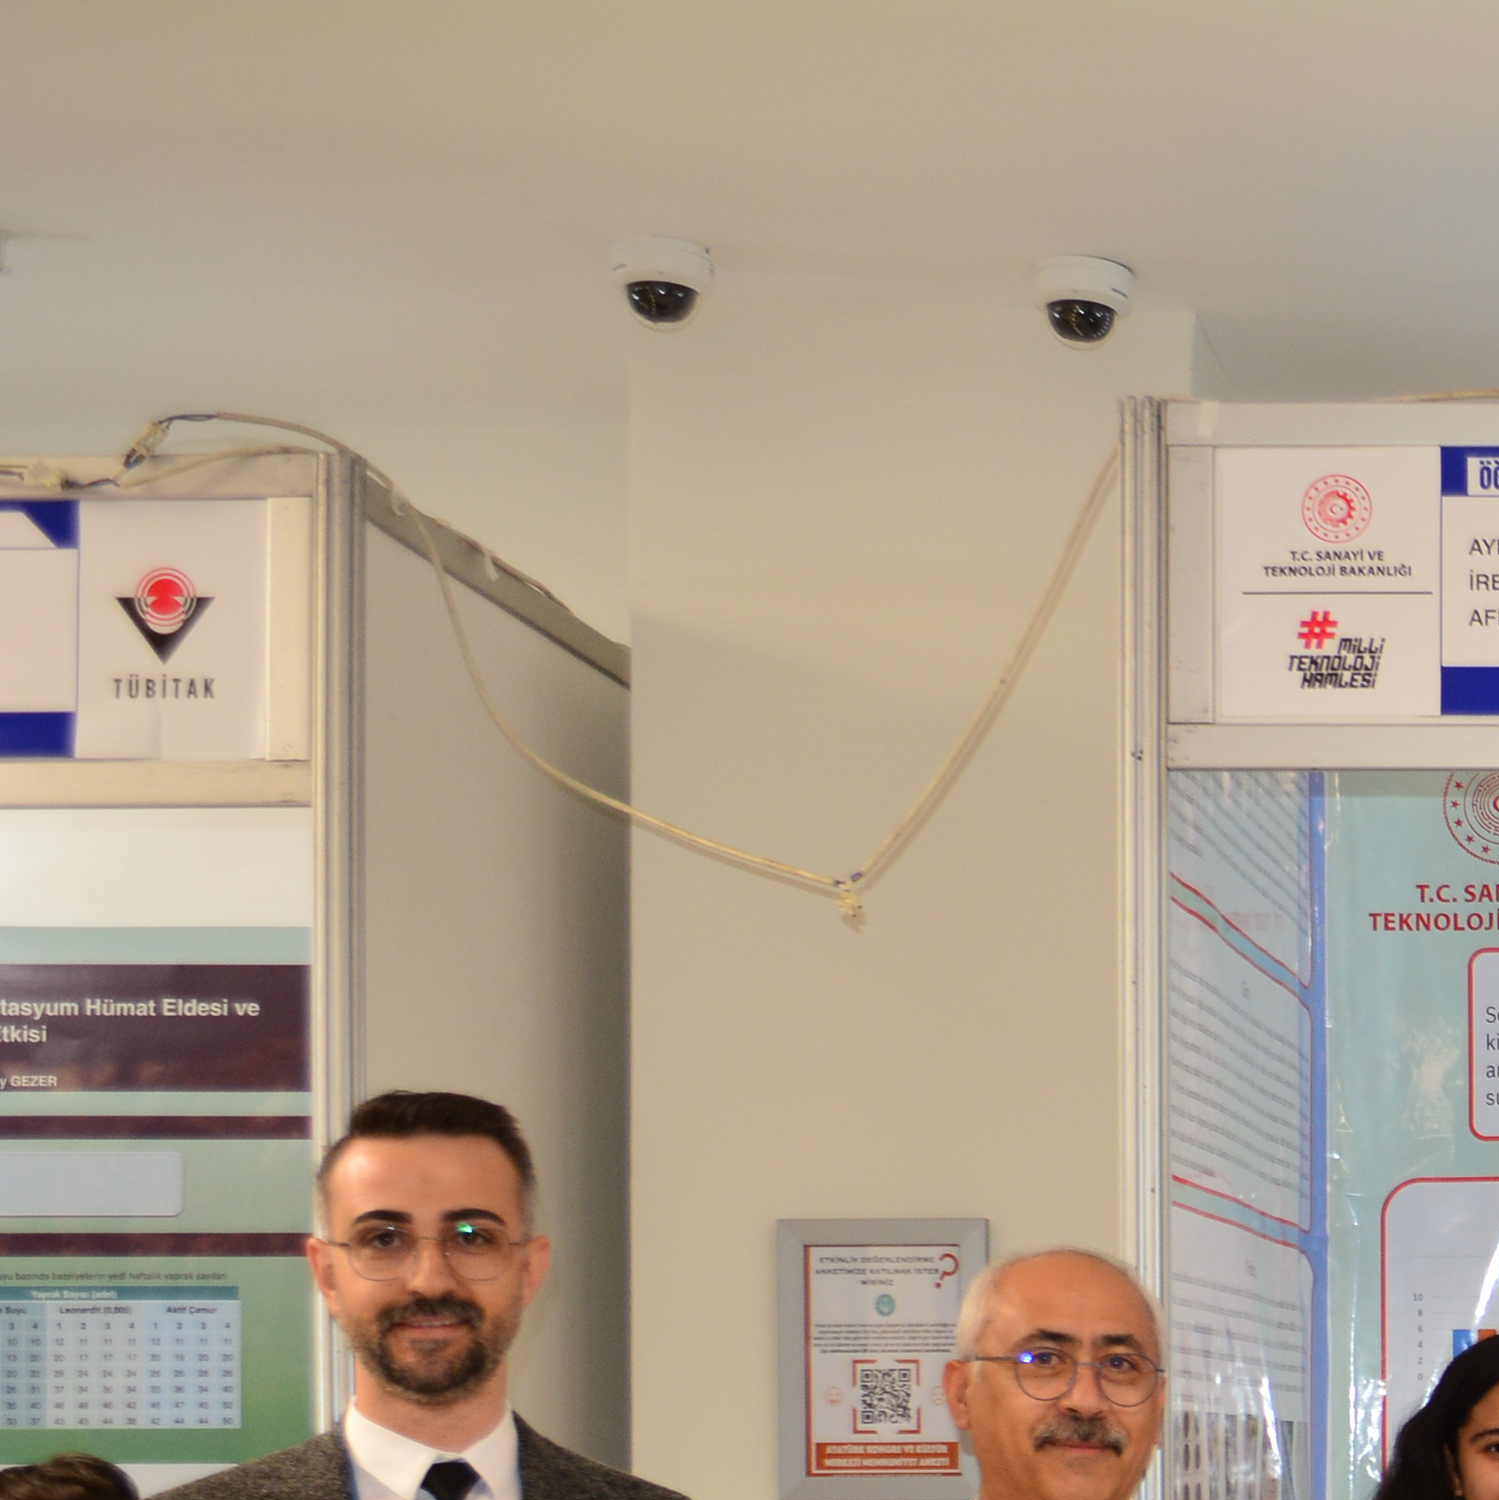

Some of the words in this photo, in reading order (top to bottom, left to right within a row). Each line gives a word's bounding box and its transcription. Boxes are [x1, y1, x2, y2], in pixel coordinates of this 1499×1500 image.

[1290, 551, 1312, 561] T.C.
[1316, 549, 1363, 561] SANAYİ
[1367, 551, 1384, 561] VE
[1263, 564, 1335, 576] TEKNOLOJİ
[1340, 564, 1411, 576] BAKANLIĞI
[113, 674, 214, 698] TÜBİTAK
[1416, 885, 1457, 902] T.C.
[85, 999, 156, 1016] Hümat
[161, 998, 228, 1016] Eldesi
[233, 1002, 260, 1016] ve
[0, 1025, 47, 1043] tkisi
[11, 1075, 57, 1086] GEZER
